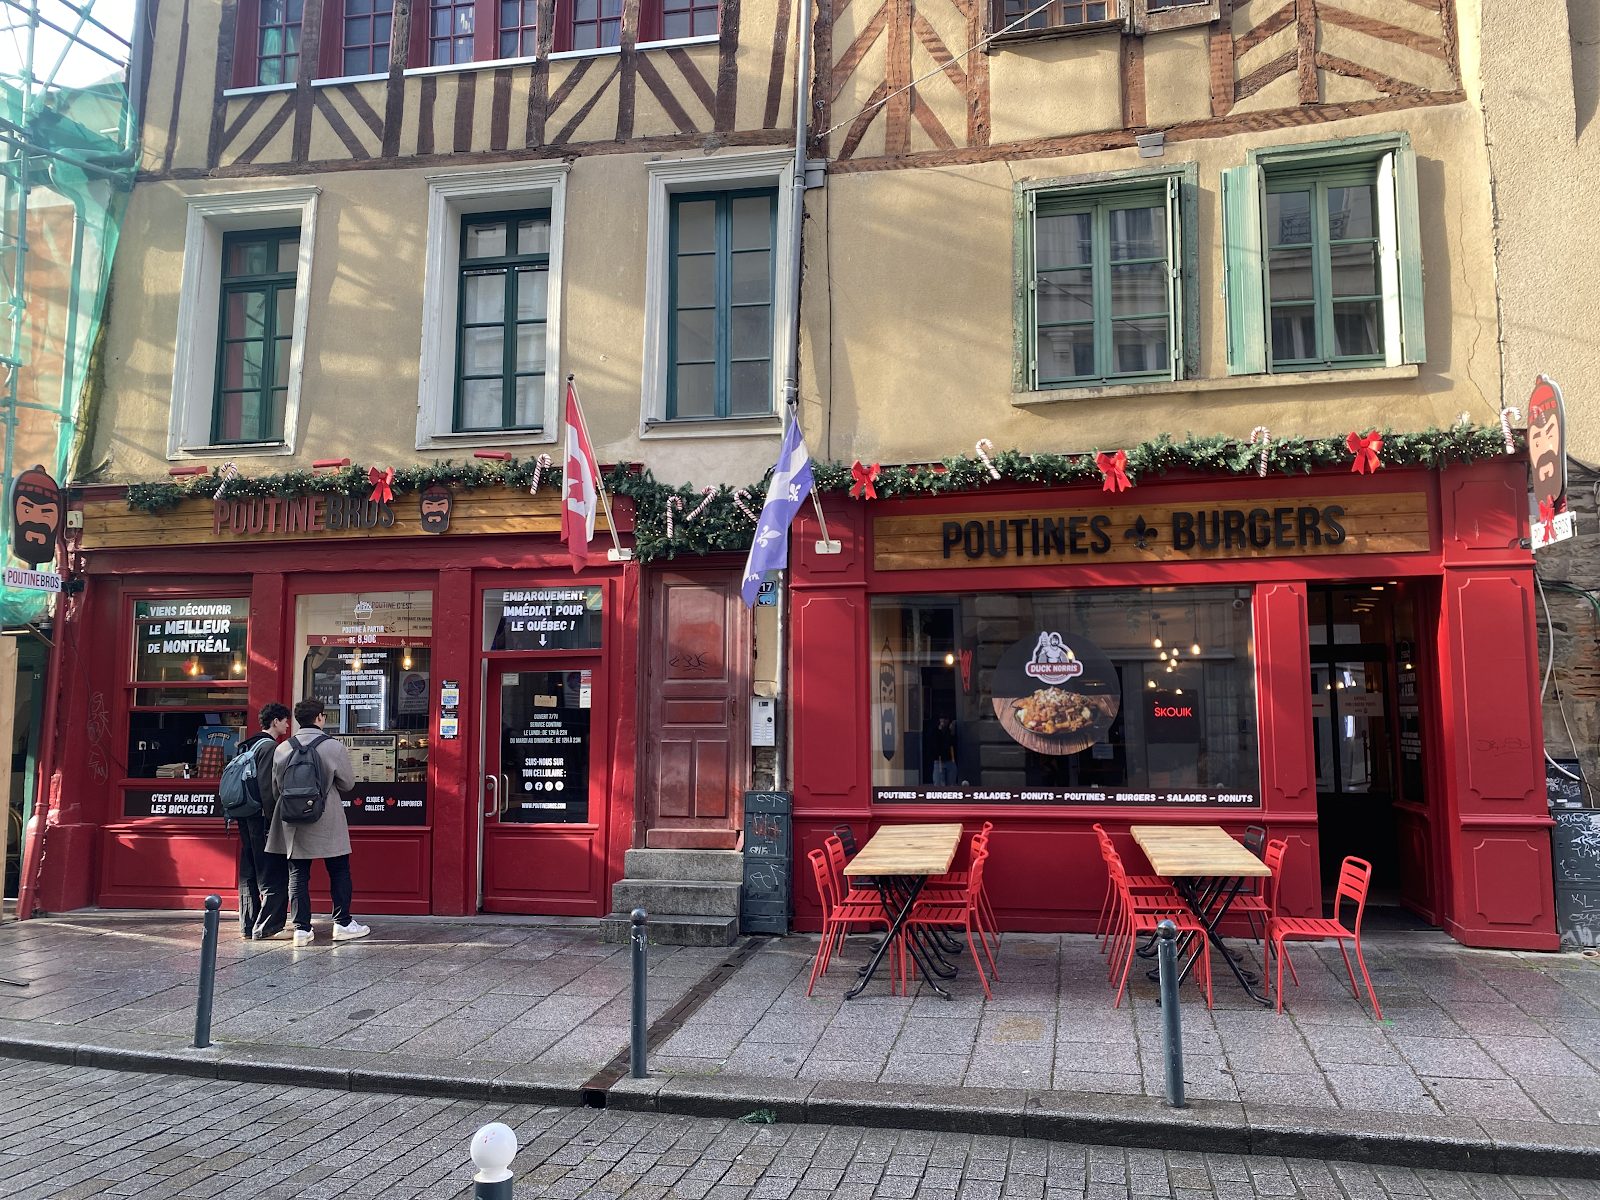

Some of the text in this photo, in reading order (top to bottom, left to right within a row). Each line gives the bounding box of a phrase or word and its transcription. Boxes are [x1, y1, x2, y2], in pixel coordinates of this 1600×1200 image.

[942, 505, 1346, 559] POUTINES BURGERS
[8, 570, 60, 588] POUTINEBROS
[761, 582, 772, 592] 17
[502, 590, 584, 601] EMBARQUEMENT
[150, 603, 232, 616] VIENS DÉCOUVRIR
[503, 603, 584, 616] IMMÉDIAT POUR
[149, 620, 230, 635] LE MEILLEUR
[511, 621, 524, 631] LE
[527, 618, 567, 631] QUÉBEC
[148, 636, 230, 653] DE MONTRÉAL
[1154, 706, 1192, 717] SKOUIK
[525, 758, 564, 766] SUIS-NOUS SUR
[522, 769, 532, 777] TON
[151, 794, 172, 802] C'EST
[191, 794, 215, 802] ICITTE
[1218, 795, 1252, 803] DONUTS
[151, 805, 166, 813] LES
[168, 805, 208, 814] BICYCLES
